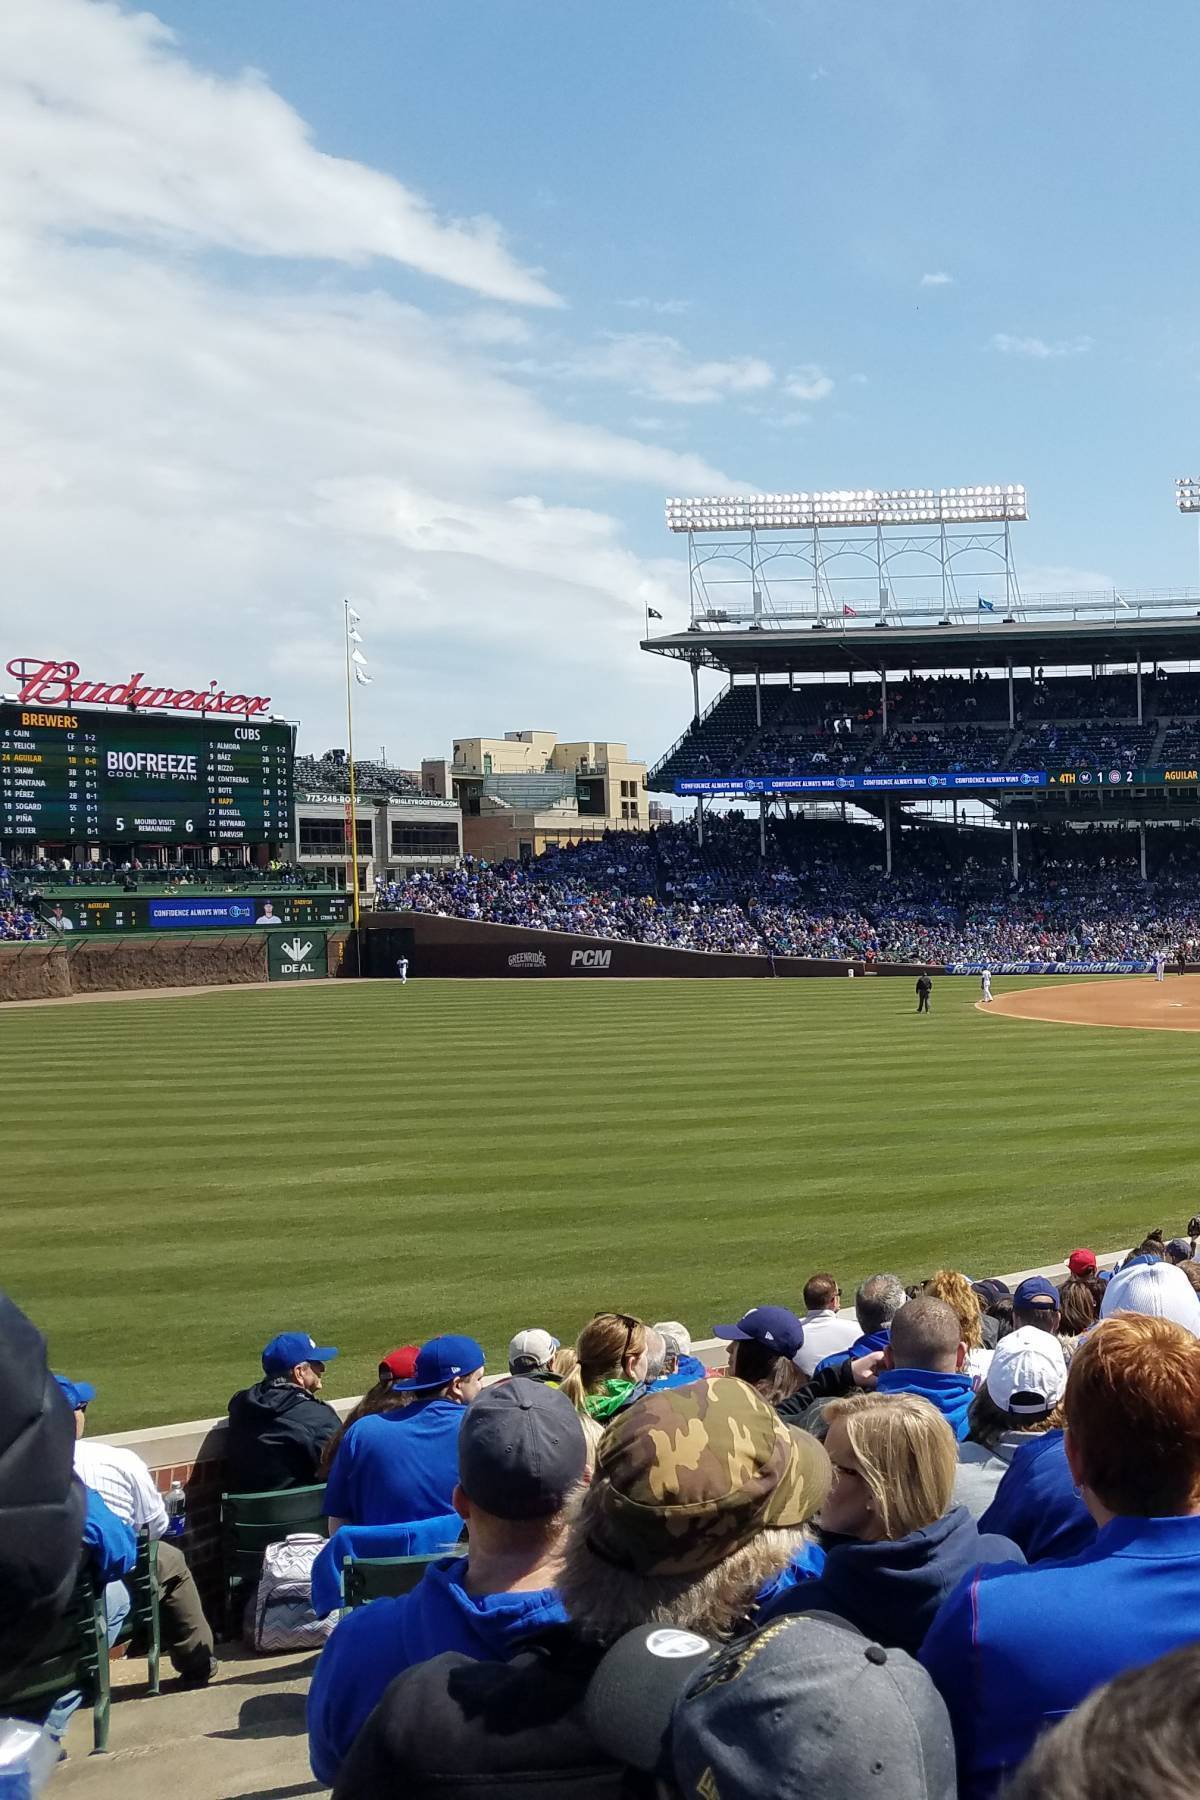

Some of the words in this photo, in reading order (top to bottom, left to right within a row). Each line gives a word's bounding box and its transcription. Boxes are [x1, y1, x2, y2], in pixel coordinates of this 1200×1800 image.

[6, 658, 271, 715] Budweiser
[22, 712, 78, 728] BREWERS
[13, 730, 30, 738] CAIN
[234, 728, 261, 741] CUBS
[13, 742, 36, 750] YELICH
[217, 742, 240, 751] ALMORA
[14, 754, 42, 762] AGUILAR
[217, 752, 231, 761] BÁEZ
[107, 751, 196, 773] BIOFREEZE
[108, 770, 140, 778] COOL
[171, 773, 197, 781] PAIN
[1059, 773, 1076, 784] 4TH
[1097, 772, 1103, 783] 1
[1126, 771, 1133, 782] 2
[1164, 770, 1198, 780] AGUILAR
[14, 779, 46, 787] SANTANA
[15, 789, 35, 798] PÉREZ
[389, 796, 457, 807] WRIGLEYROOFTOPS.COM
[15, 803, 42, 811] SOGARD
[15, 813, 32, 822] PIÑA
[116, 817, 125, 831] 5
[185, 819, 193, 832] 6
[153, 909, 189, 917] CONFIDENCE
[508, 950, 547, 966] GREENRIDGE
[570, 949, 612, 966] PCM
[281, 963, 315, 973] IDEAL
[1001, 963, 1030, 974] Wrap
[1054, 963, 1104, 973] Reynolds
[1103, 963, 1133, 974] Wrap
